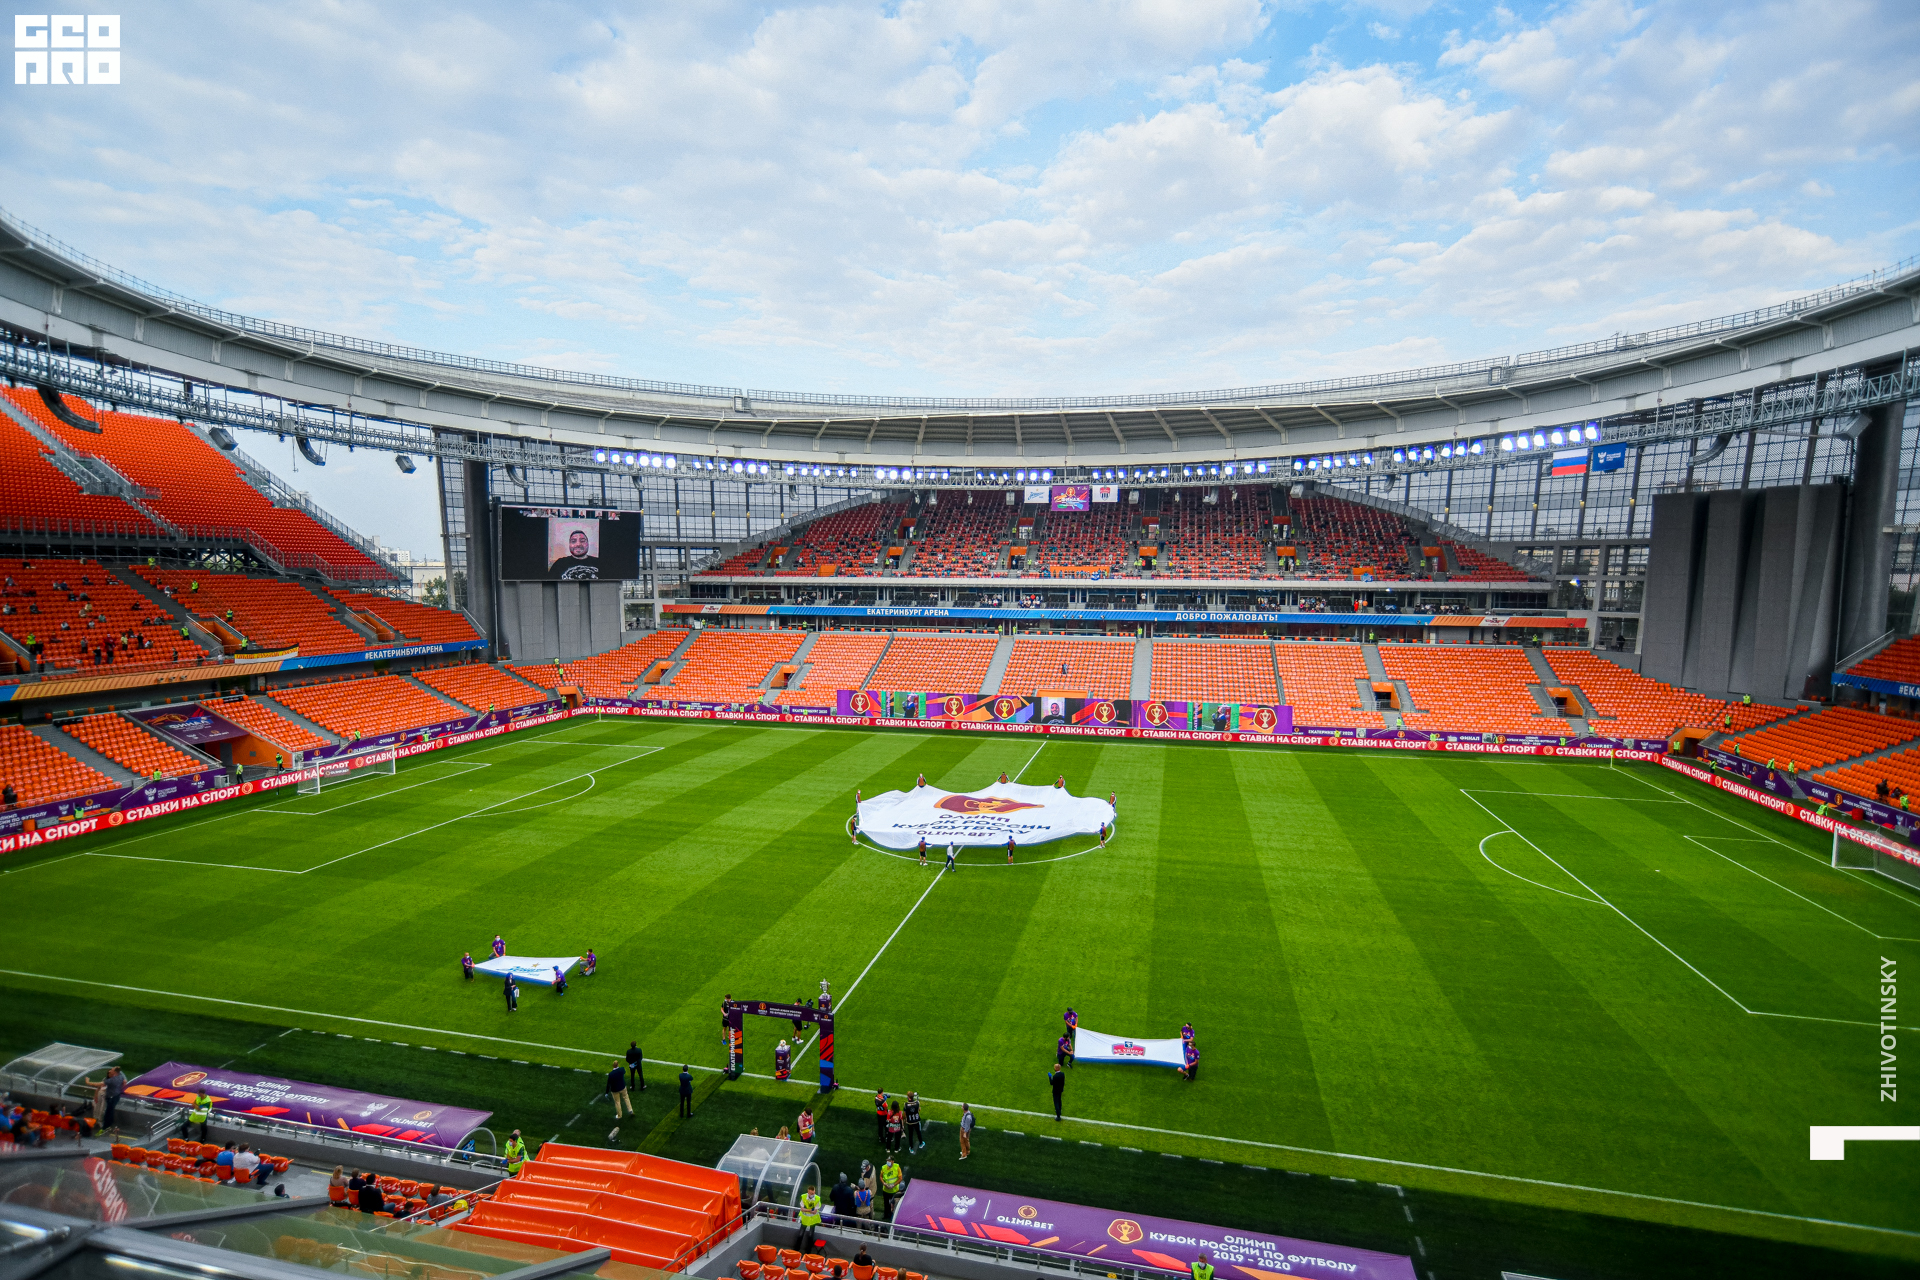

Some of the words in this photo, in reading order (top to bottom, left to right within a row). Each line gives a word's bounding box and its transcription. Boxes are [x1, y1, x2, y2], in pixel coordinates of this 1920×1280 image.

[866, 608, 923, 616] ЕКАТЕРИНБУРГ
[924, 609, 950, 617] АРЕНА
[1175, 612, 1208, 622] ДОБРО
[1210, 612, 1279, 622] ПОЖАЛОВАТЬ!
[364, 644, 444, 660] #ЕКАТЕРИНБУРГАРЕНА
[571, 706, 594, 715] СТАВКИ
[597, 706, 606, 714] НА
[606, 706, 629, 714] СПОРТ
[641, 708, 668, 716] СТАВКИ
[669, 709, 678, 717] НА
[515, 718, 537, 729] СТАВКИ
[538, 716, 546, 724] НА
[546, 712, 563, 723] СПОРТ
[716, 712, 744, 720] СТАВКИ
[744, 713, 755, 721] НА
[755, 714, 780, 722] СПОРТ
[794, 715, 823, 723] СТАВКИ
[824, 716, 835, 724] НА
[836, 717, 861, 725] СПОРТ
[918, 720, 945, 728] СПОРТ
[961, 722, 993, 730] СТАВКИ
[993, 723, 1006, 731] НА
[1006, 724, 1034, 732] СПОРТ
[448, 732, 475, 745] СТАВКИ
[475, 730, 484, 739] НА
[484, 726, 505, 737] СПОРТ
[1050, 726, 1082, 734] СТАВКИ
[1084, 727, 1097, 735] НА
[1097, 728, 1126, 736] СПОРТ
[1142, 730, 1175, 738] СТАВКИ
[1177, 731, 1190, 739] НА
[1191, 732, 1222, 740] СПОРТ
[1239, 734, 1272, 743] СТАВКИ
[1273, 735, 1286, 743] НА
[1287, 736, 1322, 745] СПОРТ
[1340, 738, 1377, 747] СТАВКИ
[1379, 740, 1393, 748] НА
[1394, 740, 1427, 749] СПОРТ
[366, 750, 398, 765] СТАВКИ
[399, 747, 410, 756] НА
[411, 741, 435, 754] СПОРТ
[1445, 742, 1484, 751] СТАВКИ
[1486, 744, 1500, 752] НА
[1502, 745, 1536, 753] СПОРТ
[1556, 747, 1598, 757] СТАВКИ
[1598, 748, 1613, 757] НА
[1615, 749, 1653, 760] СПОРТ
[1661, 757, 1683, 770] СТАВКИ
[1683, 763, 1691, 773] НА
[1691, 768, 1712, 782] СПОРТ
[261, 771, 302, 789] СТАВКИ
[304, 769, 318, 780] НА
[1722, 780, 1748, 799] СТАВКИ
[1748, 788, 1759, 801] НА
[1759, 792, 1785, 811] СПОРТ
[1811, 788, 1829, 798] ФИНАЛ
[126, 799, 179, 820] СТАВКИ
[182, 794, 200, 809] НА
[201, 786, 240, 803] СПОРТ
[892, 819, 956, 830] КУБОК
[962, 820, 1051, 830] РОССИИ
[939, 814, 1010, 823] ОЛИМП
[1800, 809, 1834, 830] СТАВКИ
[1834, 821, 1848, 836] НА
[19, 832, 43, 847] НА
[45, 818, 98, 839] СПОРТ
[200, 1079, 234, 1089] КУБОК
[231, 1083, 273, 1095] РОССИИ
[268, 1089, 285, 1097] ПО
[285, 1092, 330, 1104] ФУТБОЛУ
[256, 1081, 292, 1091] ОЛИМП
[229, 1090, 252, 1099] 2019
[255, 1094, 280, 1103] 2020
[390, 1117, 437, 1129] OLIMP.BET
[996, 1214, 1055, 1231] OLIMP.BET
[1223, 1234, 1276, 1251] ОЛИМП
[1149, 1231, 1197, 1246] КУБОК
[1199, 1238, 1260, 1256] РОССИИ
[1263, 1250, 1285, 1261] ПО
[1286, 1254, 1357, 1272] ФУТБОЛУ
[1213, 1250, 1245, 1263] 2019
[1257, 1257, 1291, 1271] 2020
